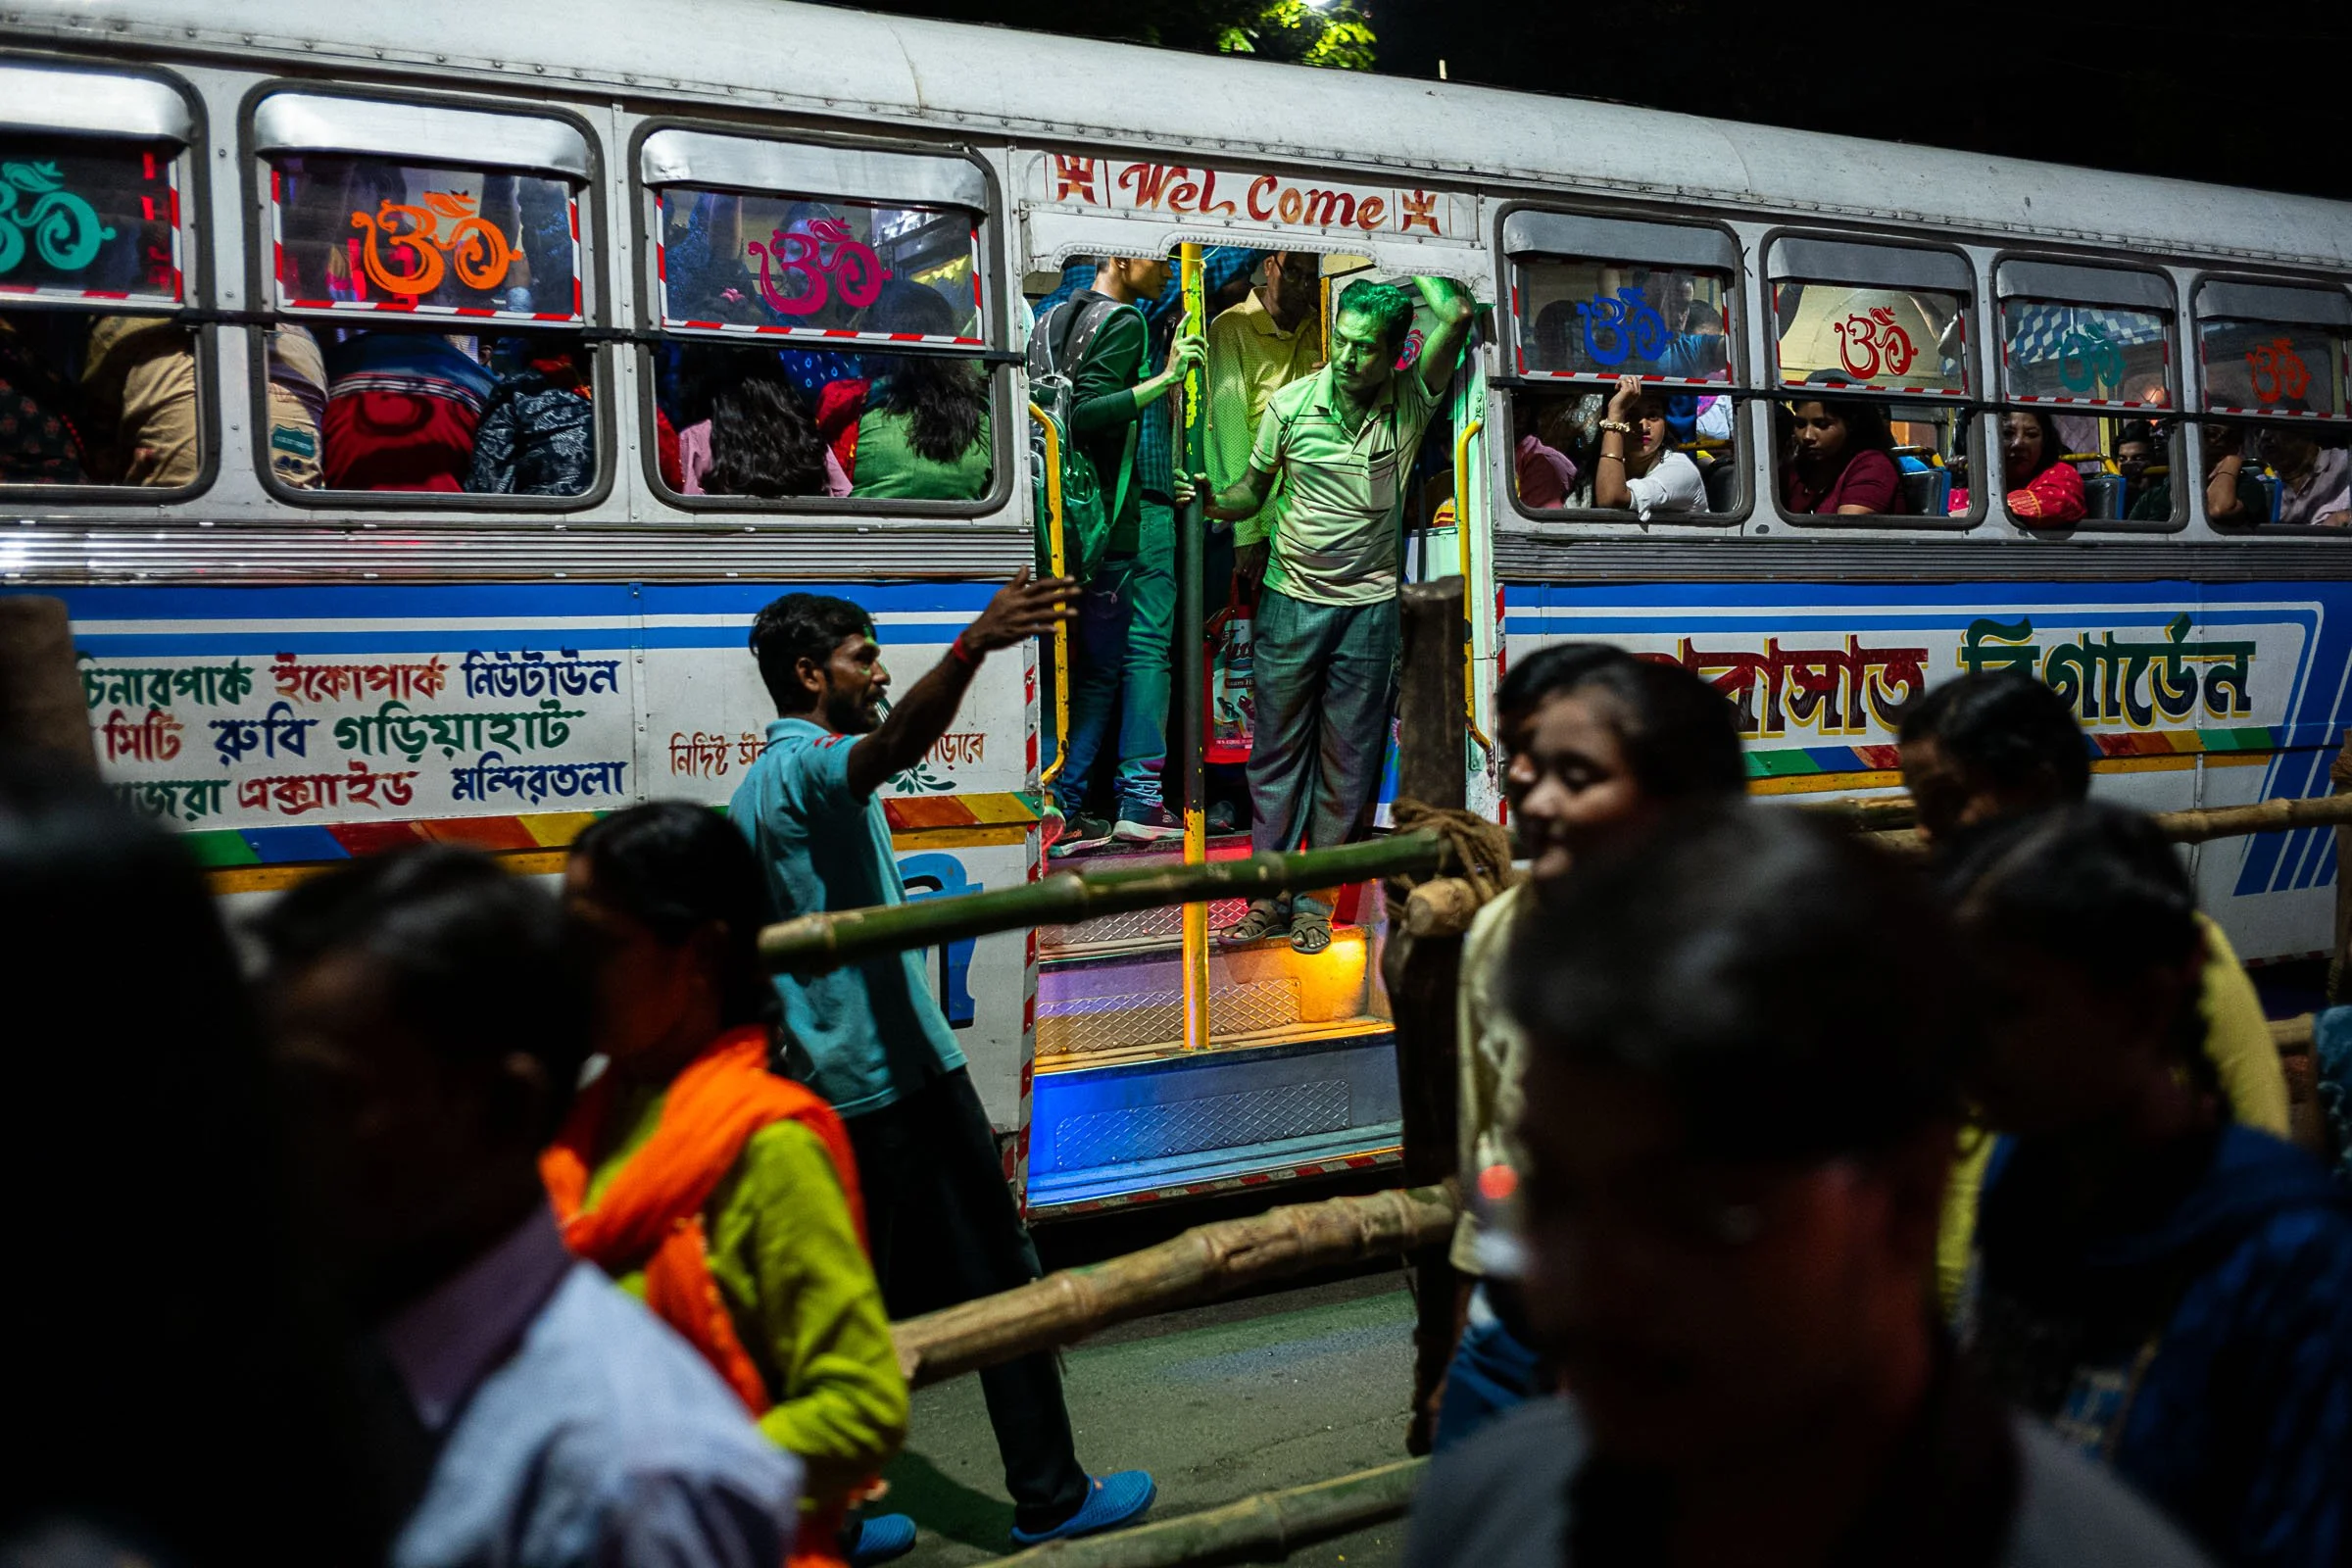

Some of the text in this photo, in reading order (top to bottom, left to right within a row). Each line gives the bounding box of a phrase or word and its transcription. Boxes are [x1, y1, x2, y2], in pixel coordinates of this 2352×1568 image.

[1247, 173, 1388, 230] Come
[268, 651, 451, 707] ইকোপার্ক
[460, 646, 622, 699] নিউটাউন
[101, 698, 587, 767] সিটি রুবি গড়িয়াহাট
[237, 759, 420, 815] এক্সাইড
[452, 751, 628, 806] মন্দিরতলা
